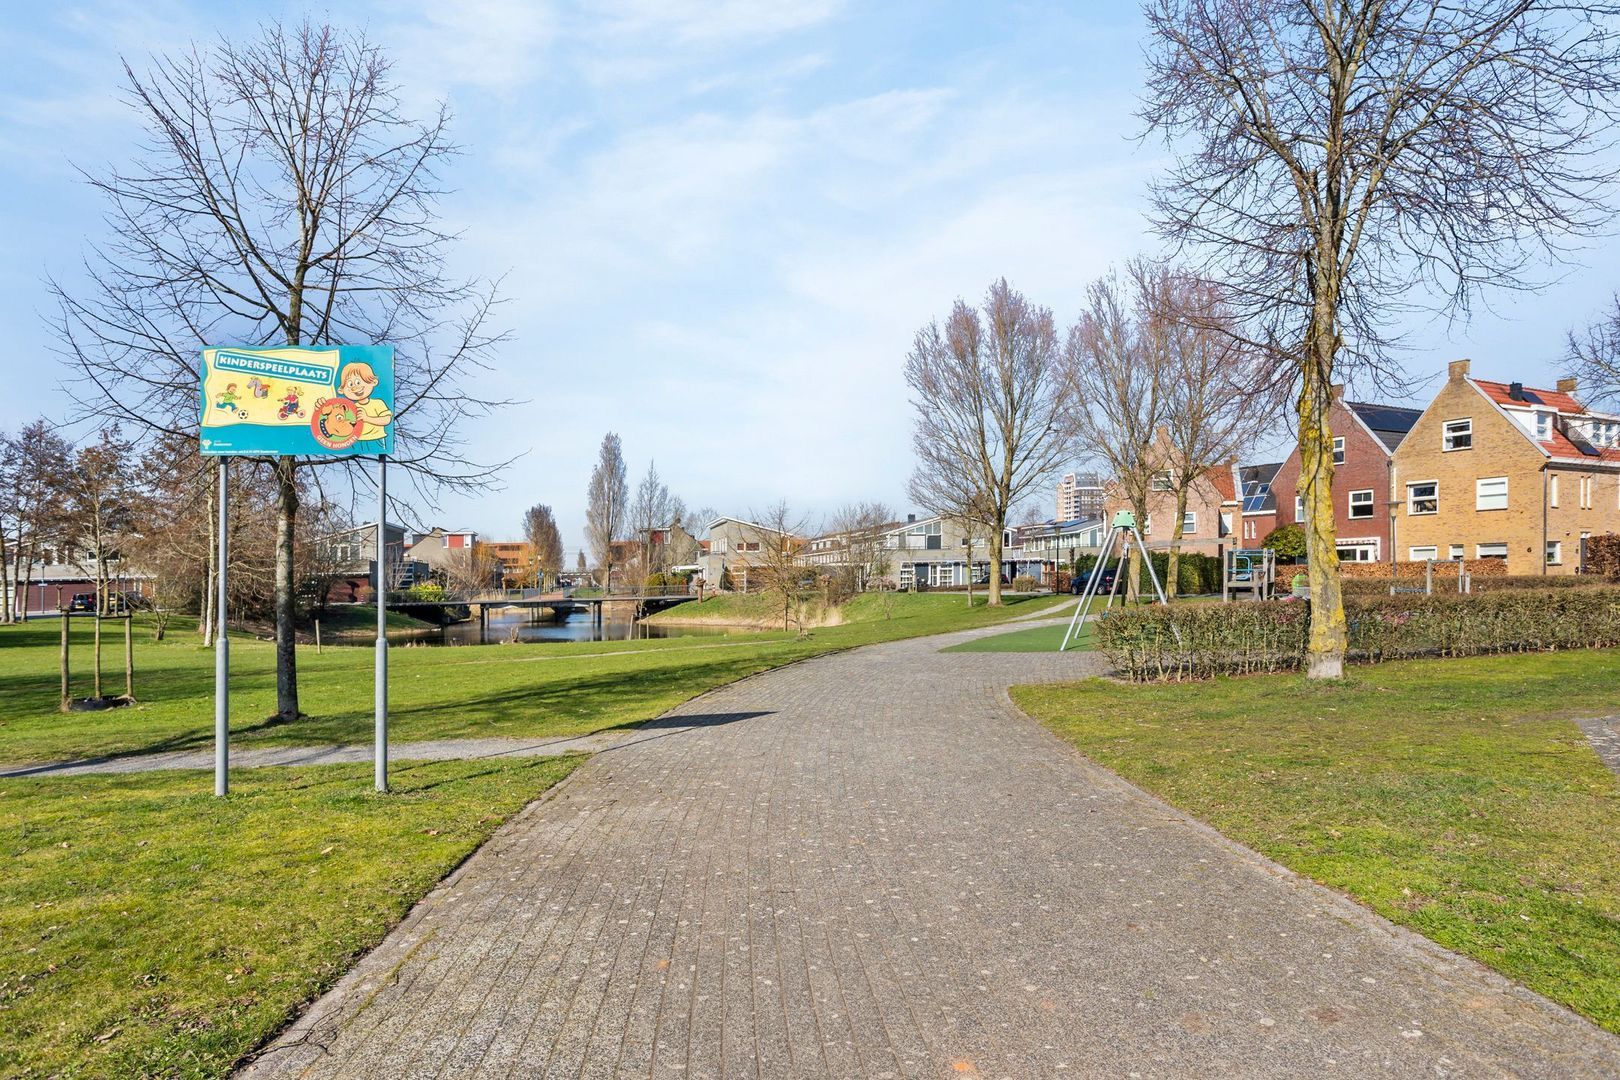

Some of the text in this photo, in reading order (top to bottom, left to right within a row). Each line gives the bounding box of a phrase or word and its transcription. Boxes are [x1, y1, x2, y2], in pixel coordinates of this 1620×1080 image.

[219, 355, 328, 379] KINDERSPEELPLAATS
[317, 434, 358, 449] GEEN HONDEN
